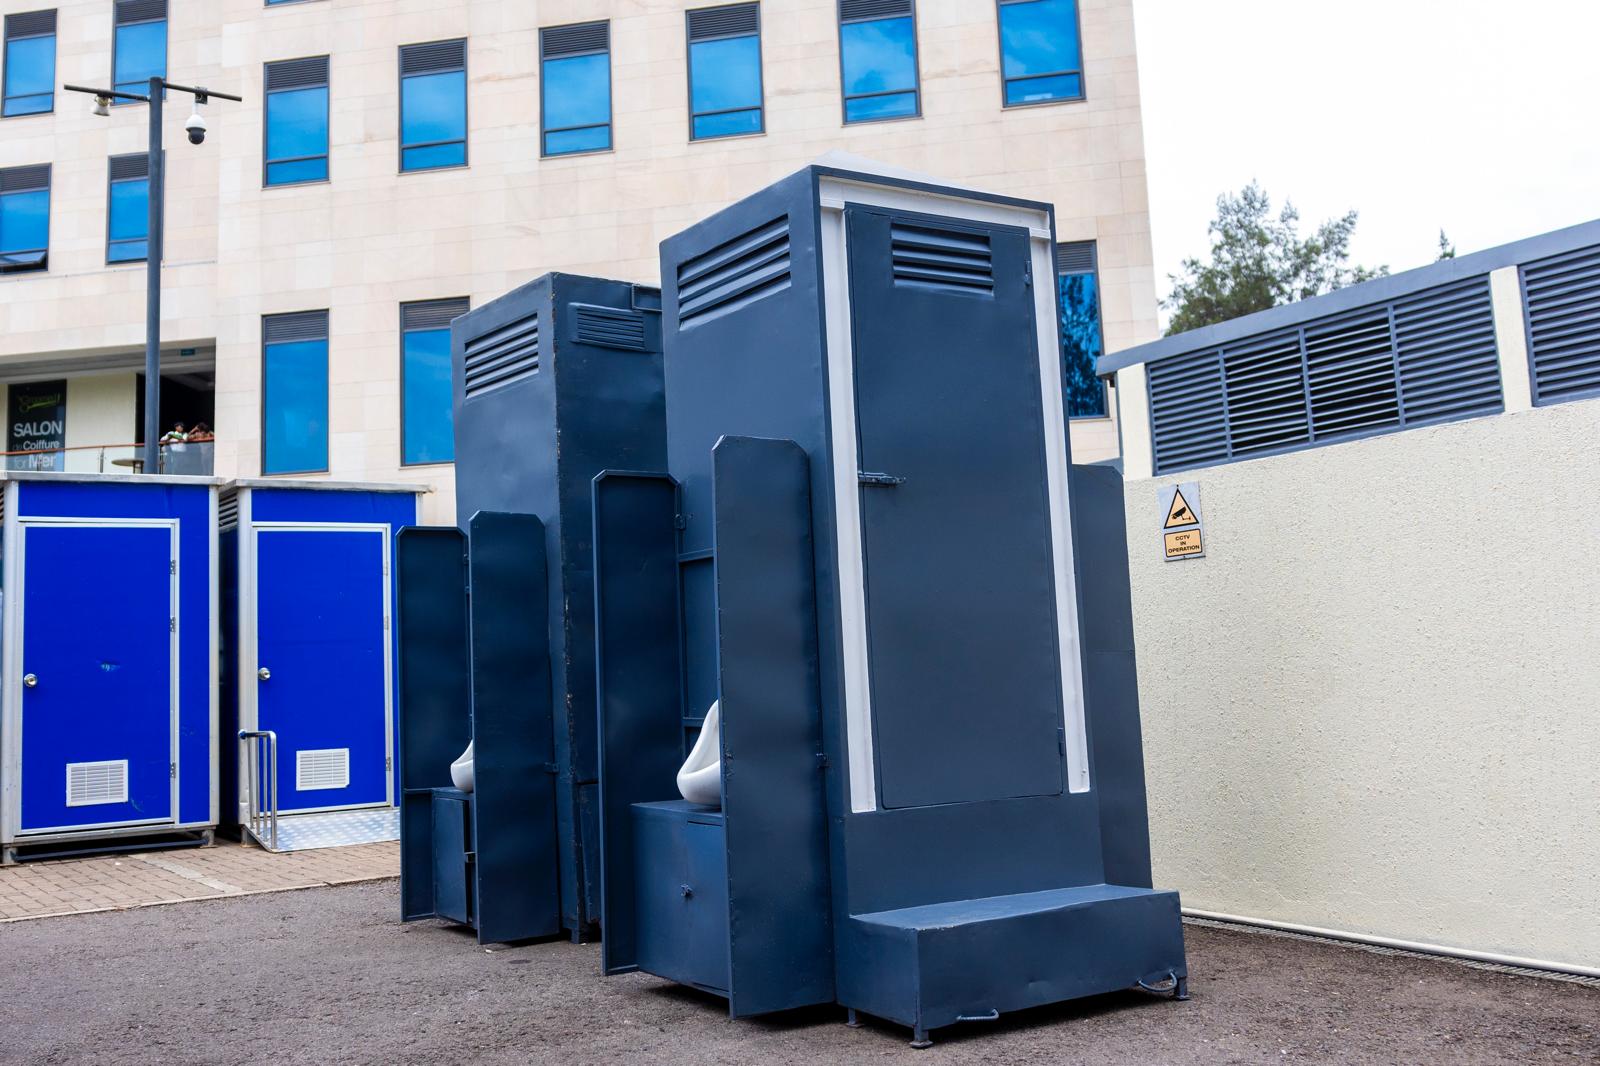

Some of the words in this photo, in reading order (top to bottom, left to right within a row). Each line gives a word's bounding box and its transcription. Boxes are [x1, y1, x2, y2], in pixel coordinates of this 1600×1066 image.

[14, 421, 62, 437] SALON
[23, 440, 60, 450] Coiffure
[1168, 545, 1200, 553] OPERATION
